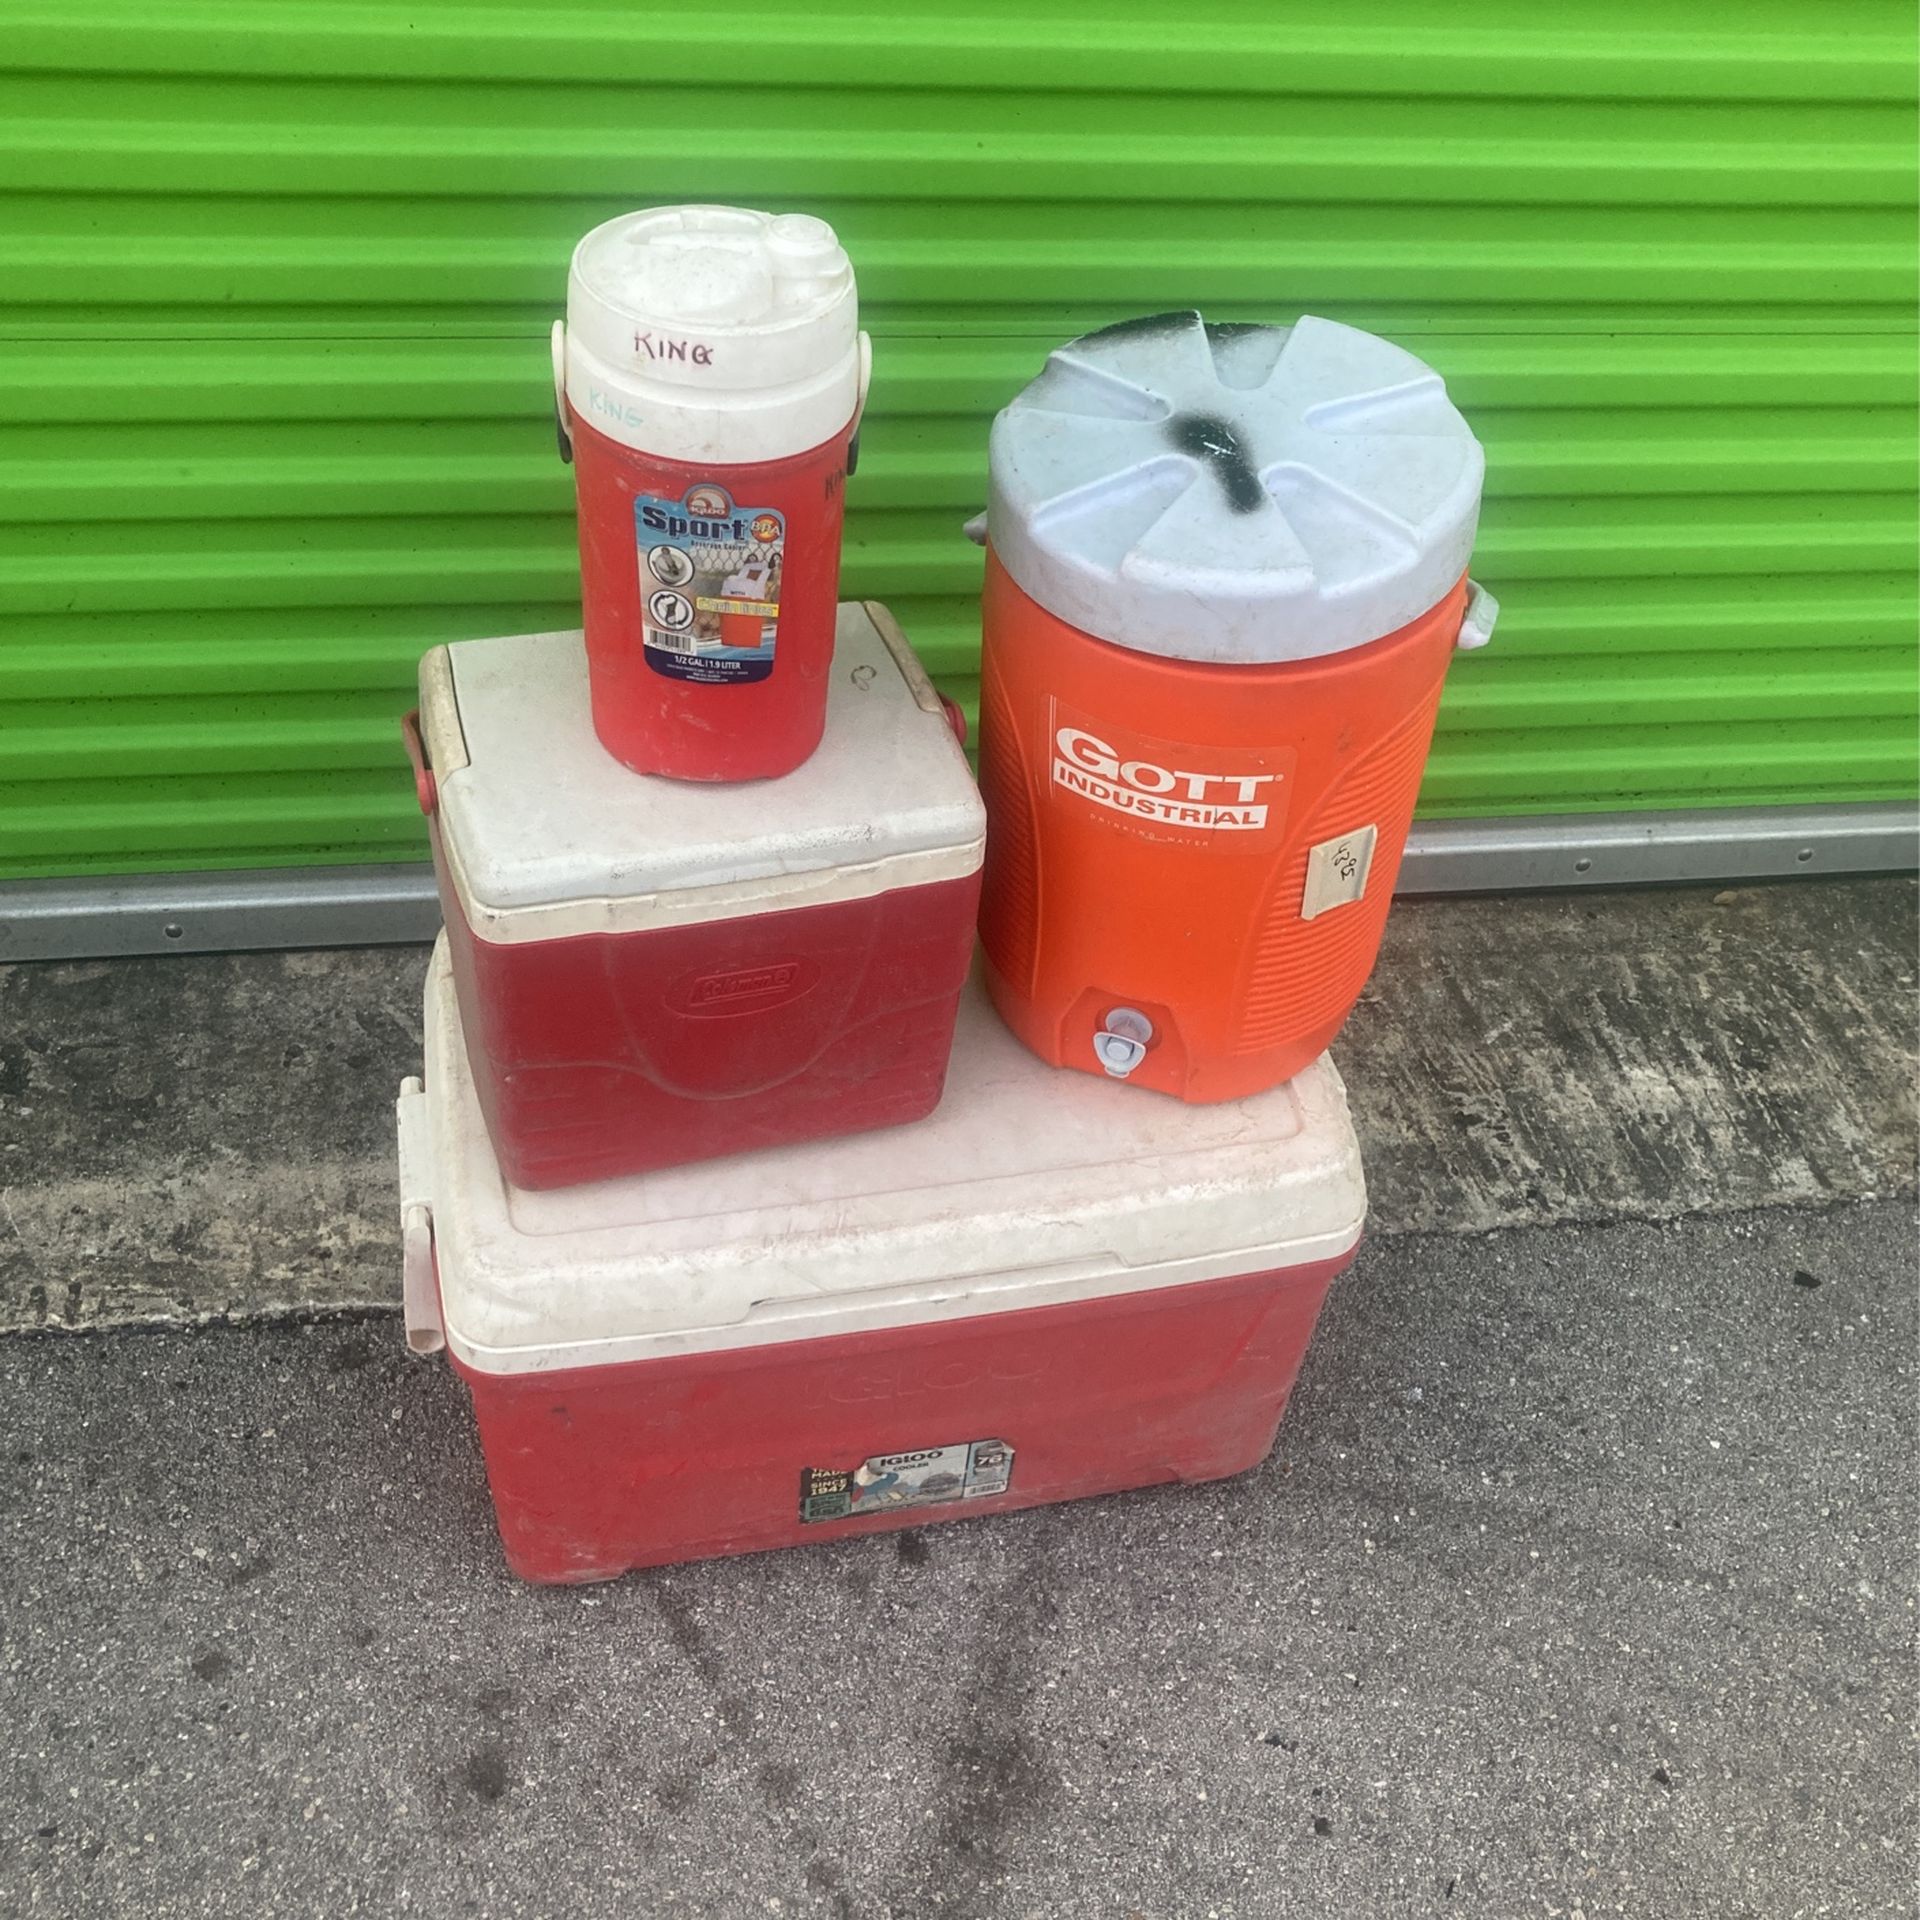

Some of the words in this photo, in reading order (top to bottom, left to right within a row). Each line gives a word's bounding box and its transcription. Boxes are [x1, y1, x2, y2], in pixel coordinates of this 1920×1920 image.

[634, 330, 714, 365] KING
[642, 505, 746, 539] Sport
[674, 655, 687, 665] 1/2
[721, 661, 742, 670] LITER
[1058, 765, 1260, 825] INDUSTRIAL
[1167, 836, 1209, 846] WATER
